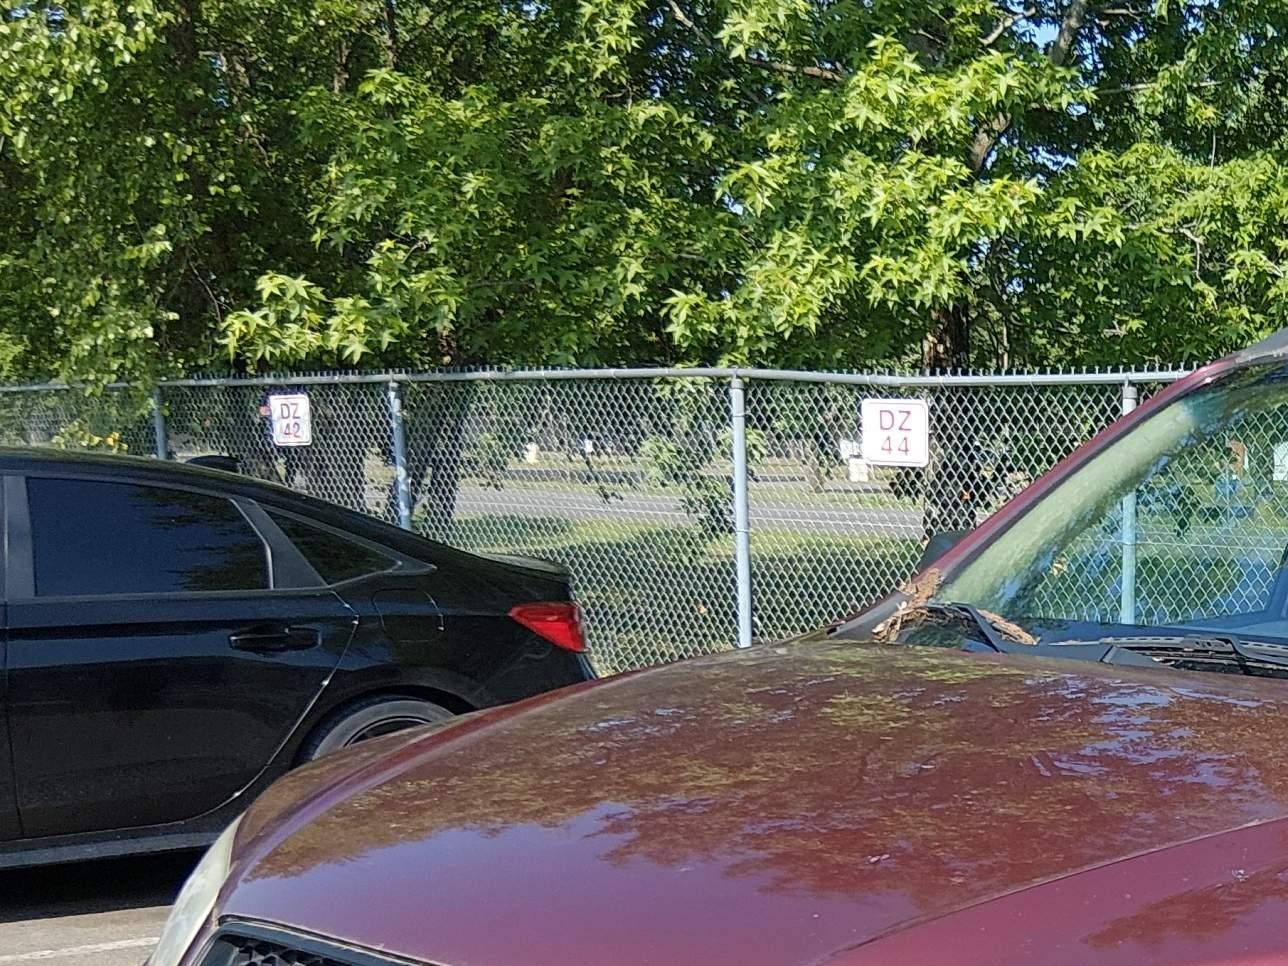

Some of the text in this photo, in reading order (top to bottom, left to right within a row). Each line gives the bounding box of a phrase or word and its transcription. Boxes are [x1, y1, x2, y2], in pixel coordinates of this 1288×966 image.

[280, 402, 301, 420] DZ
[879, 409, 912, 432] DZ
[283, 422, 301, 438] 42
[880, 435, 910, 456] 44
